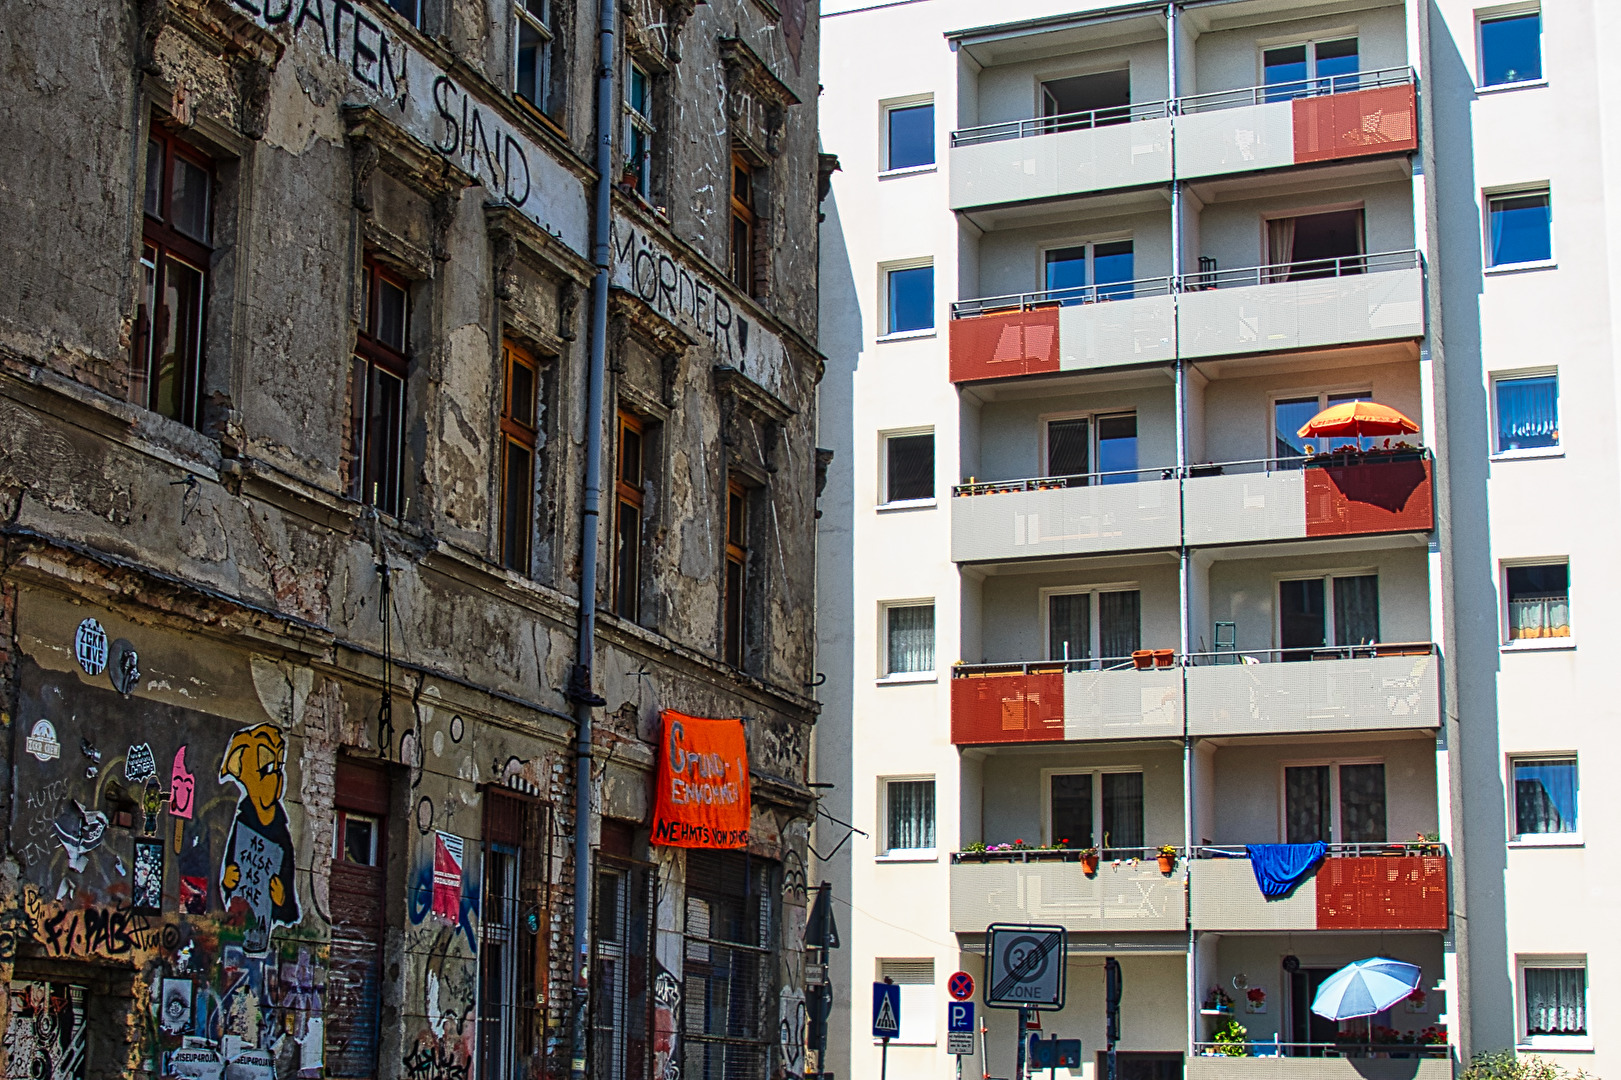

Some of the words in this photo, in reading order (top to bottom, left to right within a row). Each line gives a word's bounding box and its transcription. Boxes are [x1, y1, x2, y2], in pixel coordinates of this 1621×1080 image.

[433, 75, 531, 208] SIND
[609, 220, 748, 373] MÖRDER!
[250, 835, 264, 852] AS
[240, 849, 273, 876] FALSE
[245, 867, 260, 886] AS
[239, 885, 262, 907] THE
[1007, 985, 1042, 999] ZONE
[953, 1006, 966, 1028] P
